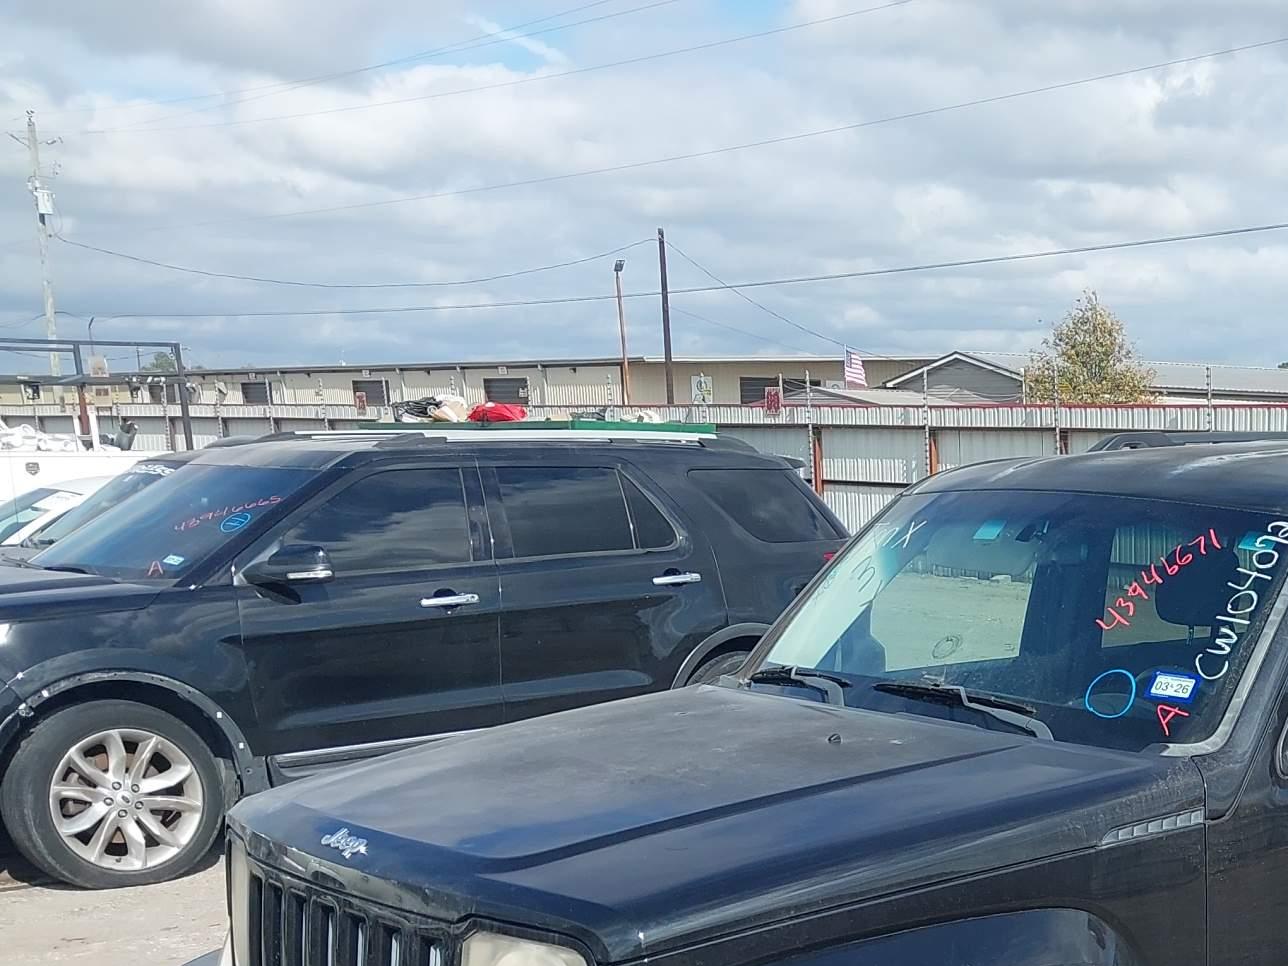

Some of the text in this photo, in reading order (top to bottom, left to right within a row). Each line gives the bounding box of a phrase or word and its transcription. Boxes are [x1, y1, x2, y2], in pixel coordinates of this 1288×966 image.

[1095, 527, 1223, 632] 43946671
[1154, 680, 1191, 695] 03 26
[1156, 703, 1191, 737] A
